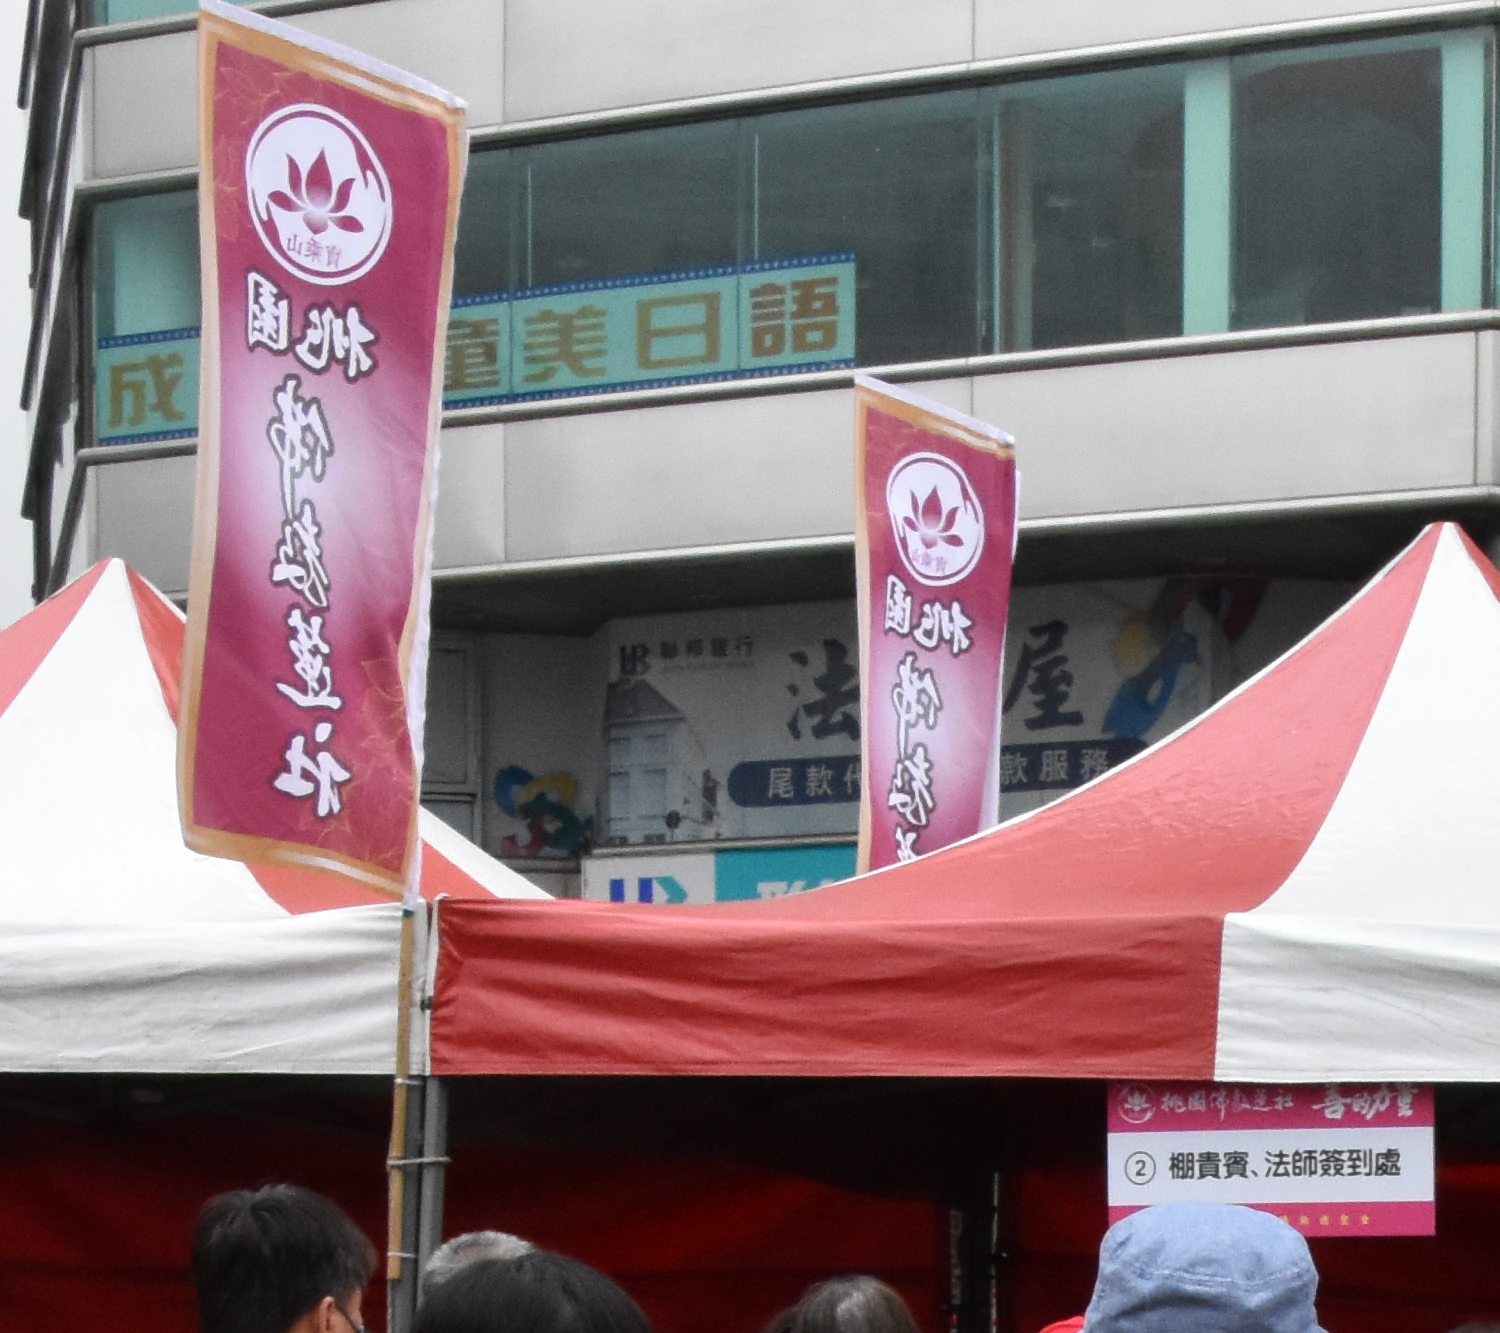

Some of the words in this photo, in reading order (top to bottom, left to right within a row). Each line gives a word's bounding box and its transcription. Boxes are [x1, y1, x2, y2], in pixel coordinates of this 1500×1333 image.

[1169, 1149, 1401, 1180] 棚貴賓、法師簽到處
